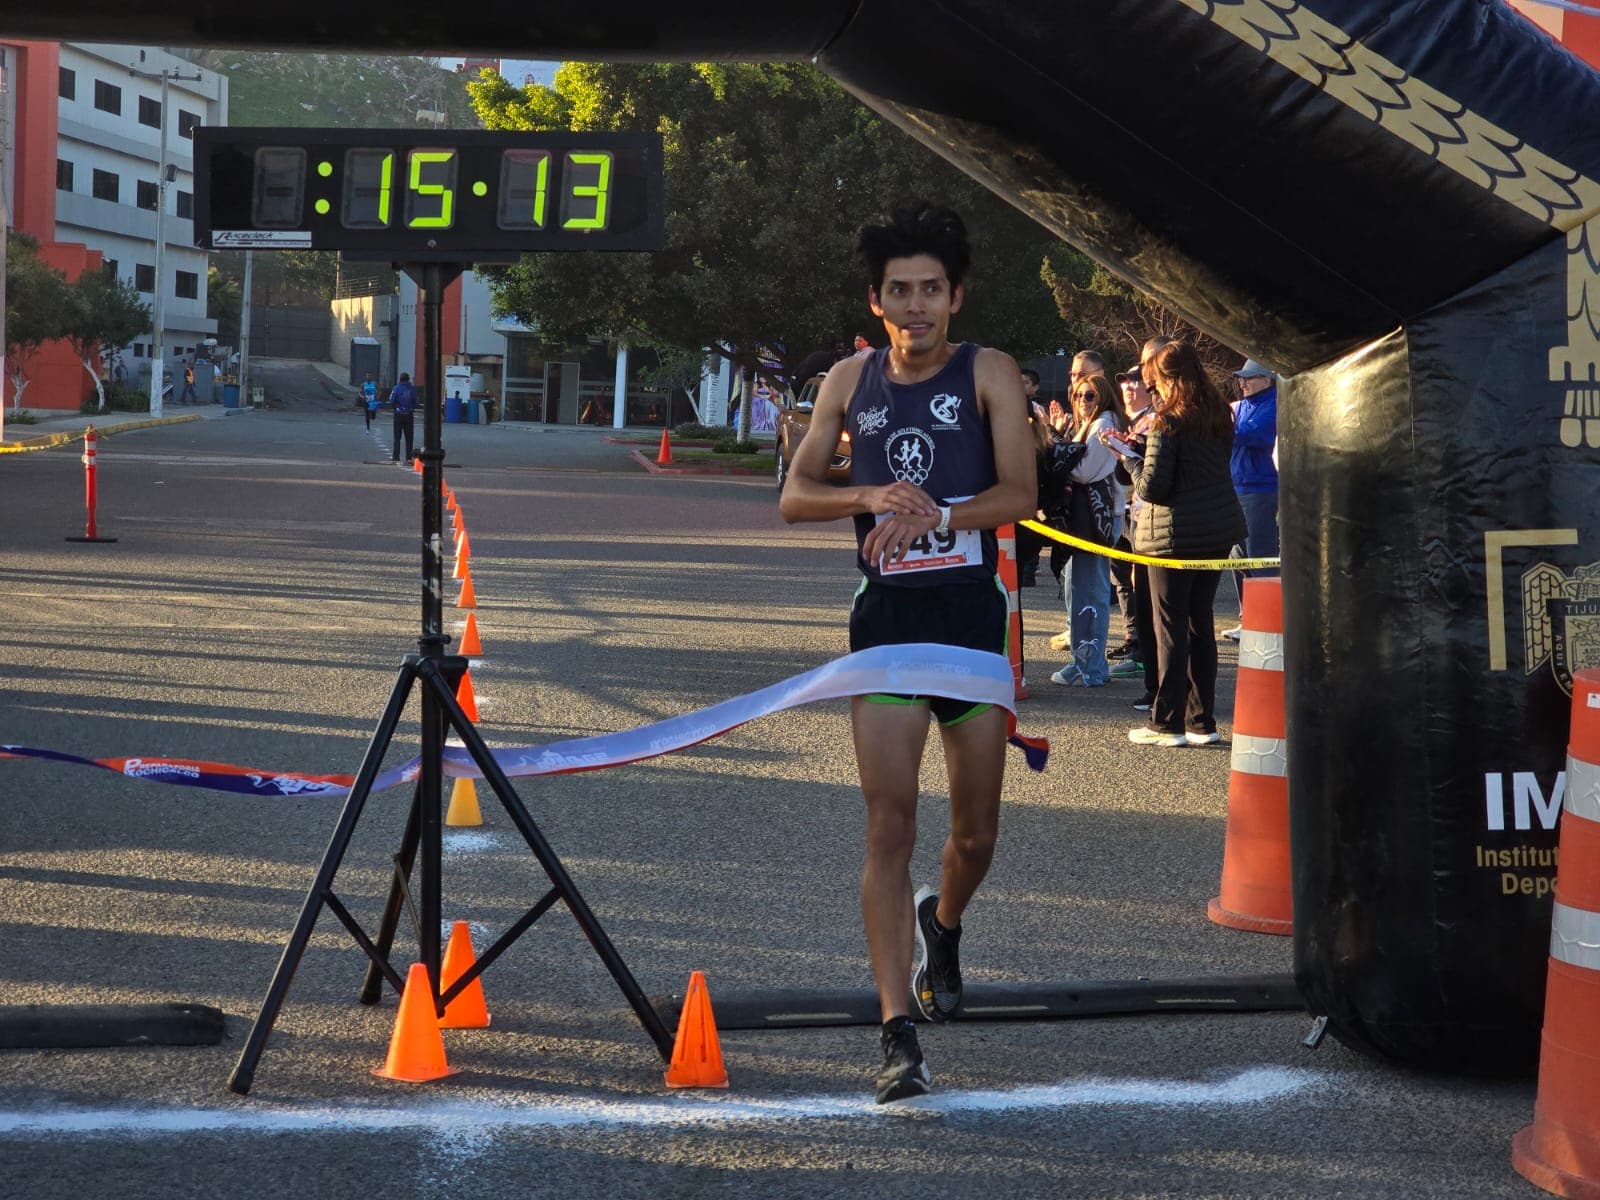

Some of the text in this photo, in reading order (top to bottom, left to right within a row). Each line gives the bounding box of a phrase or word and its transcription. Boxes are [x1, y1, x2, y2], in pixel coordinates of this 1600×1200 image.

[891, 529, 956, 557] 49
[1566, 604, 1600, 614] TIJU
[124, 766, 200, 778] XOCHICALCO
[1485, 771, 1566, 830] IM
